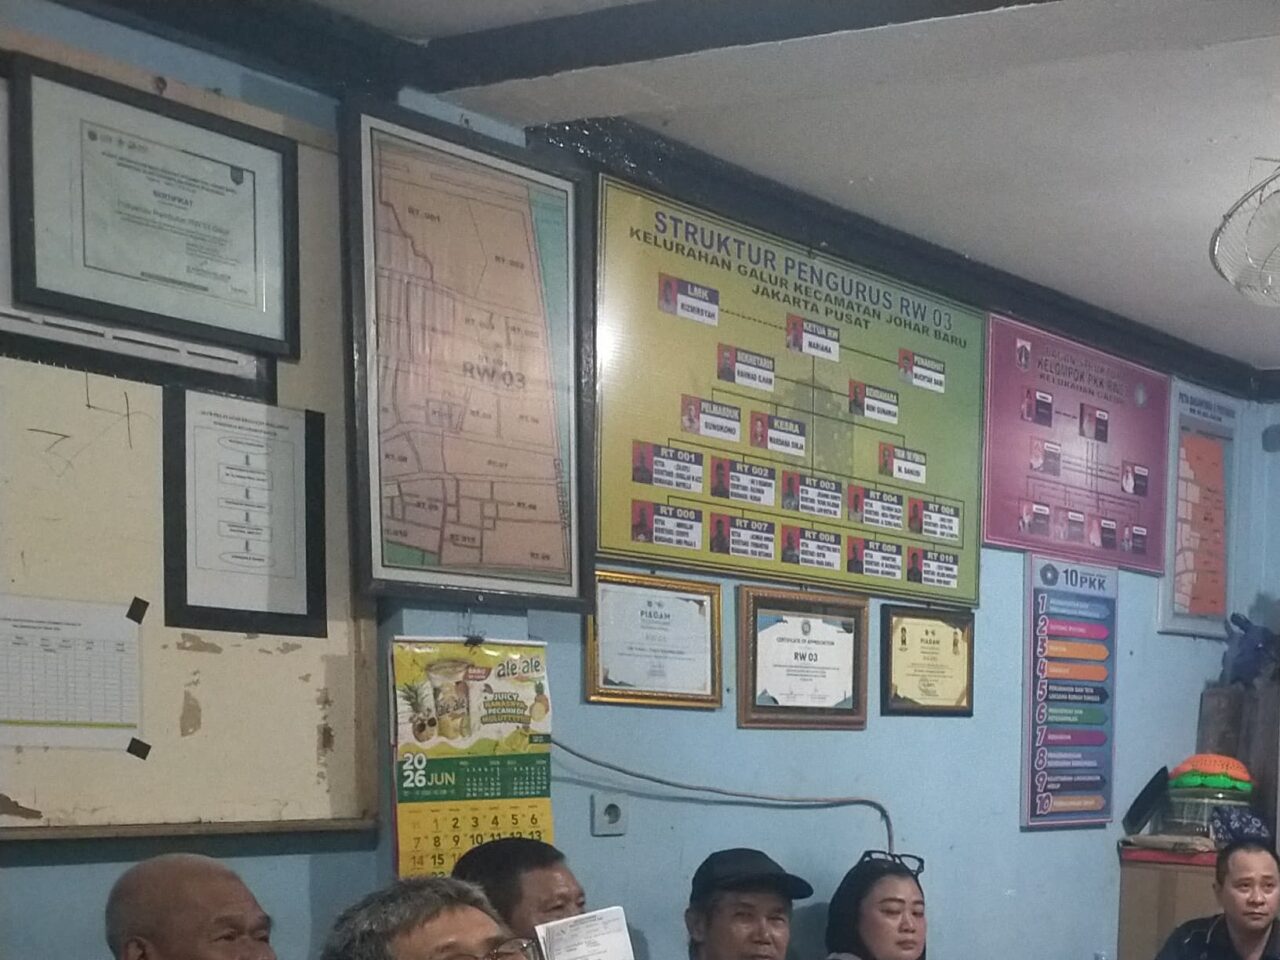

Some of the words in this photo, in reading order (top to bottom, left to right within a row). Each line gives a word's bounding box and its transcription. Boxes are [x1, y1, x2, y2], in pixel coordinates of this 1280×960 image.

[653, 211, 777, 273] STRUKTUR
[783, 256, 893, 311] PENGURUS
[899, 295, 928, 323] RW
[932, 307, 953, 332] 03
[629, 225, 733, 274] KELURAHAN
[737, 264, 791, 291] GALUR
[794, 277, 881, 321] KECAMATAN
[885, 308, 931, 338] JOHAR
[934, 328, 968, 349] BARU
[751, 283, 820, 315] JAKARTA
[824, 306, 872, 331] PUSAT
[462, 361, 497, 382] RW
[501, 370, 527, 391] 03
[660, 447, 676, 459] RT
[677, 450, 696, 462] 001
[736, 463, 750, 474] RT
[751, 466, 769, 477] 002
[805, 476, 818, 487] RT
[660, 505, 675, 516] RT
[735, 517, 750, 528] RT
[804, 529, 818, 540] RT
[1063, 568, 1079, 587] 10
[1080, 576, 1107, 592] PKK
[1038, 594, 1048, 614] 1
[1036, 615, 1049, 636] 2
[1036, 636, 1049, 658] 3
[794, 652, 808, 662] RW
[808, 653, 818, 662] 03
[1036, 658, 1049, 679] 4
[1036, 679, 1048, 702] 5
[1036, 702, 1048, 724] 6
[1036, 725, 1048, 747] 7
[402, 753, 427, 770] 20
[1034, 747, 1048, 770] 8
[402, 770, 427, 788] 26
[427, 772, 456, 786] JUN
[1035, 771, 1048, 792] 9
[1036, 792, 1053, 816] 10
[452, 817, 460, 830] 2
[471, 816, 479, 828] 3
[491, 815, 500, 827] 4
[511, 813, 519, 826] 5
[530, 813, 538, 826] 6
[413, 836, 421, 849] 7
[433, 836, 441, 848] 8
[452, 834, 460, 847] 9
[470, 833, 484, 846] 10
[528, 830, 542, 842] 13
[411, 854, 424, 867] 14
[430, 853, 445, 866] 15
